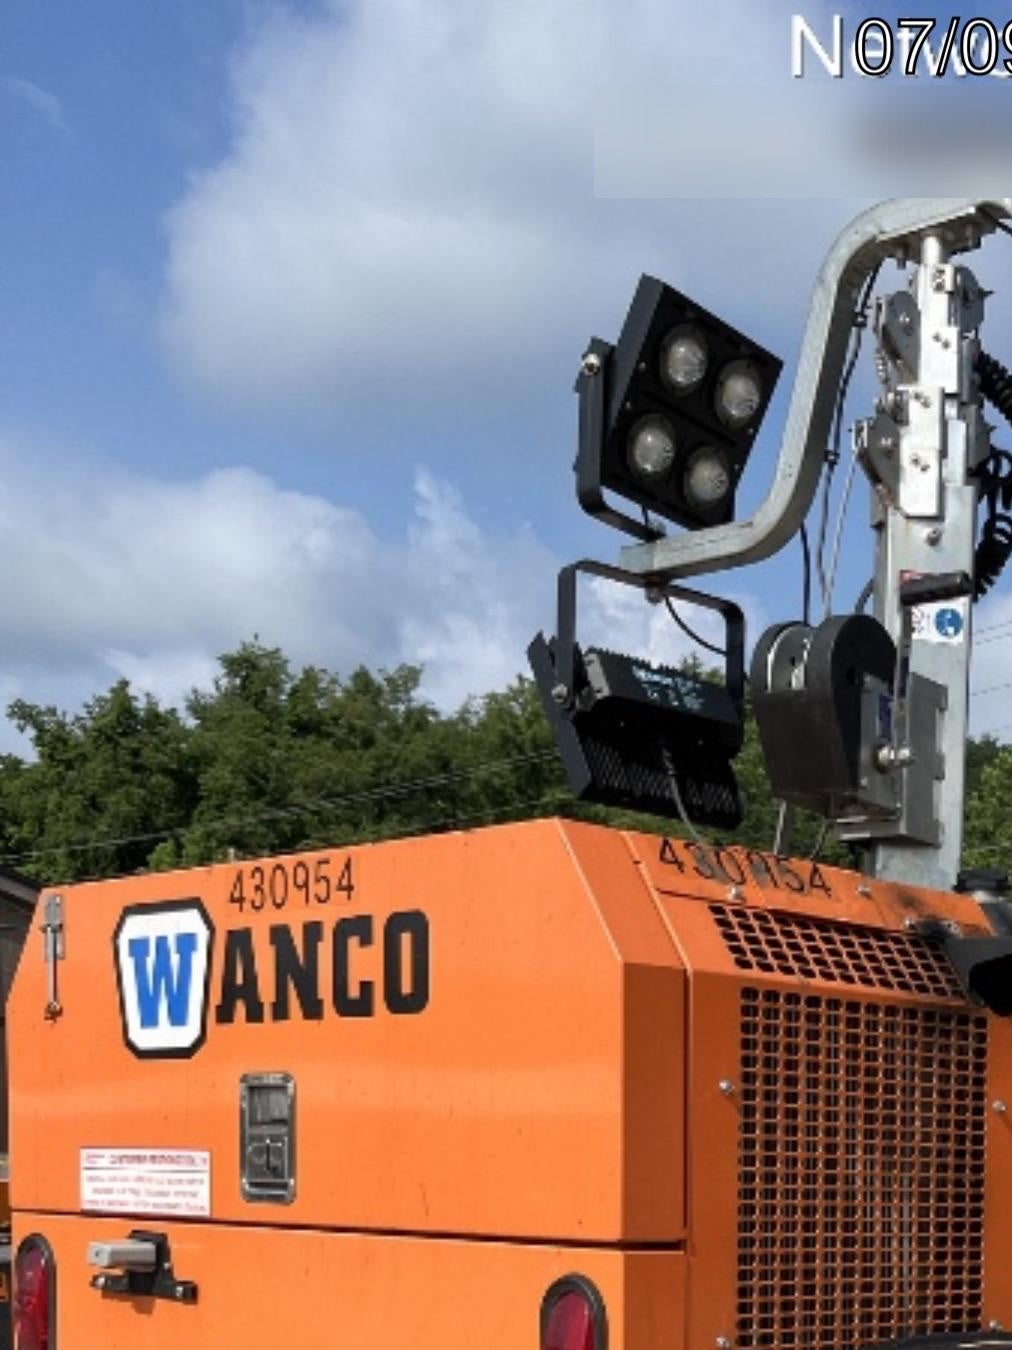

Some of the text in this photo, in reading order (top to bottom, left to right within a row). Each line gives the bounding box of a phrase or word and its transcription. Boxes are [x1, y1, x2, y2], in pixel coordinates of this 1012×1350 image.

[228, 856, 356, 913] 430954
[659, 836, 832, 899] 430954
[126, 907, 430, 1030] WANCO
